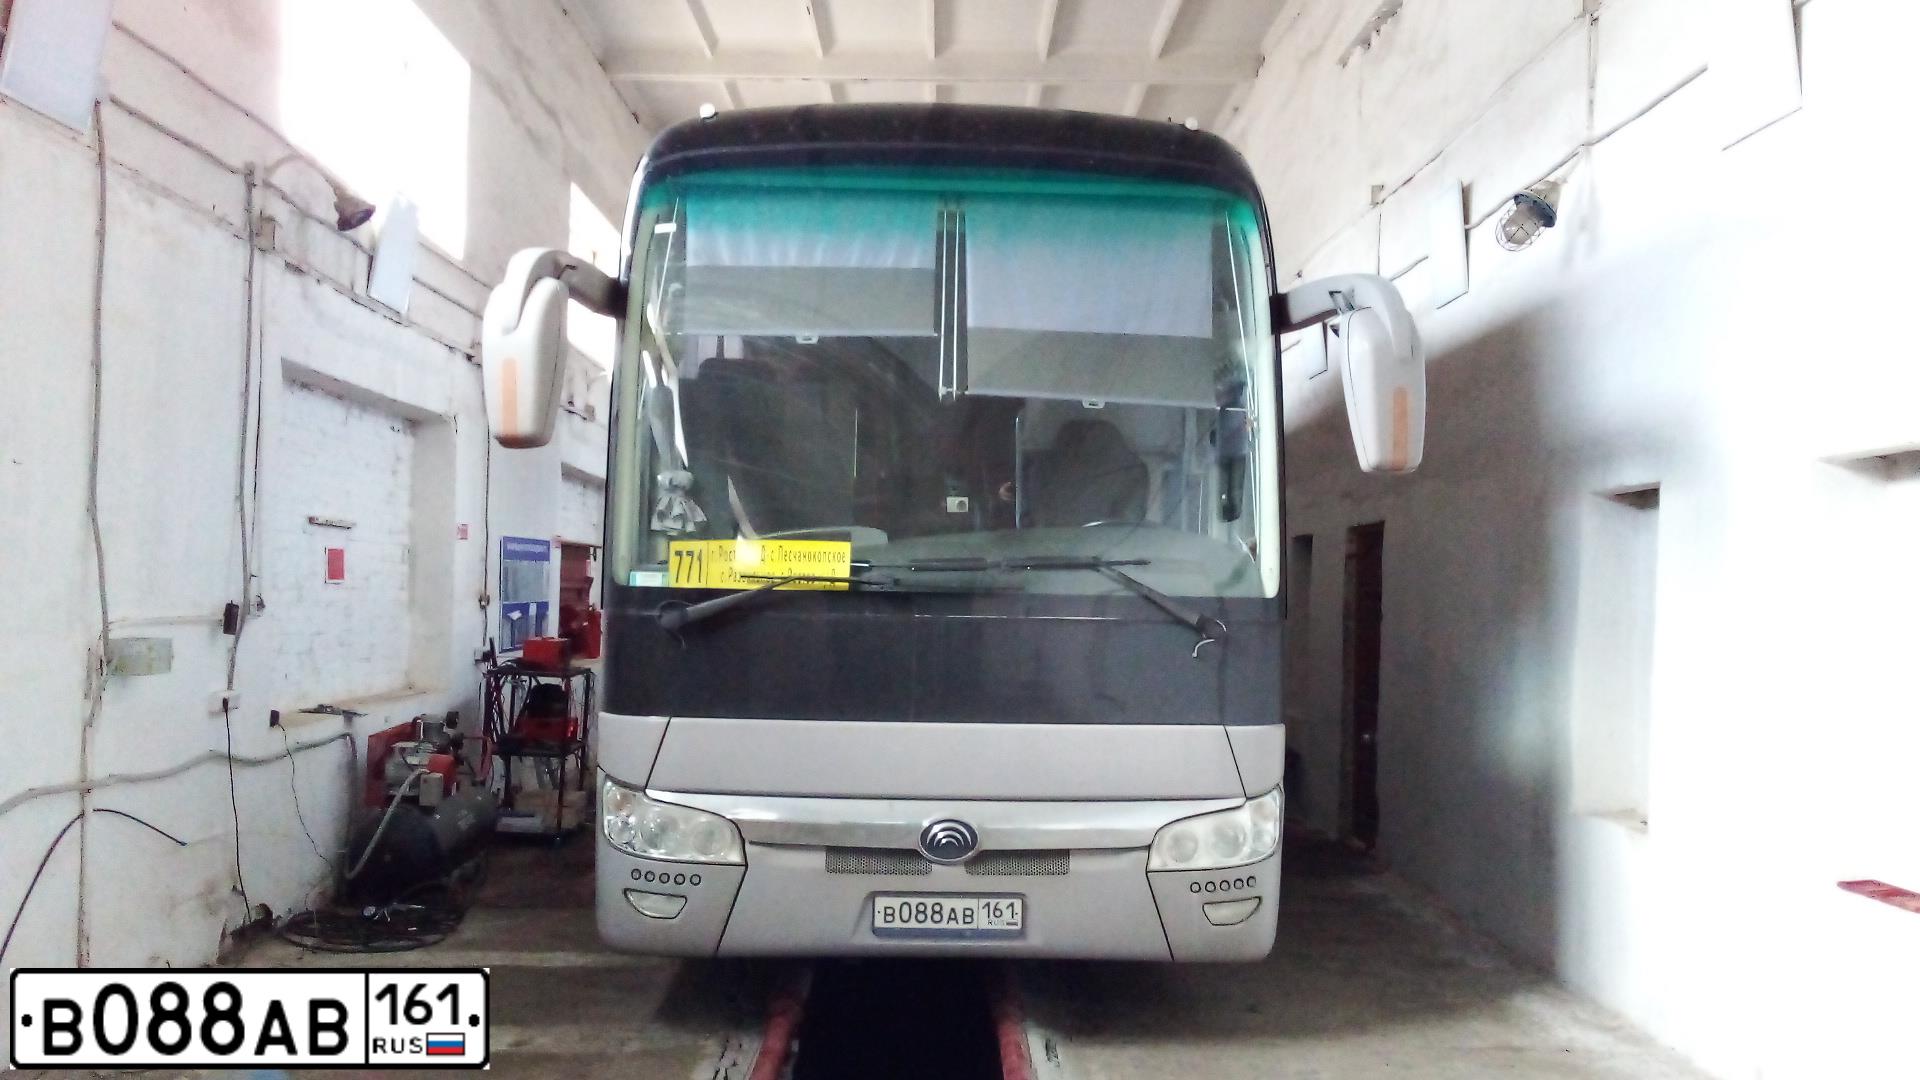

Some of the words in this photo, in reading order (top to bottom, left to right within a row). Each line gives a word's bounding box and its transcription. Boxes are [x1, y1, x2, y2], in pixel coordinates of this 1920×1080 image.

[777, 544, 846, 563] Песчанокопское
[674, 548, 703, 584] 771
[883, 901, 975, 925] В088АВ
[981, 901, 1016, 920] 161
